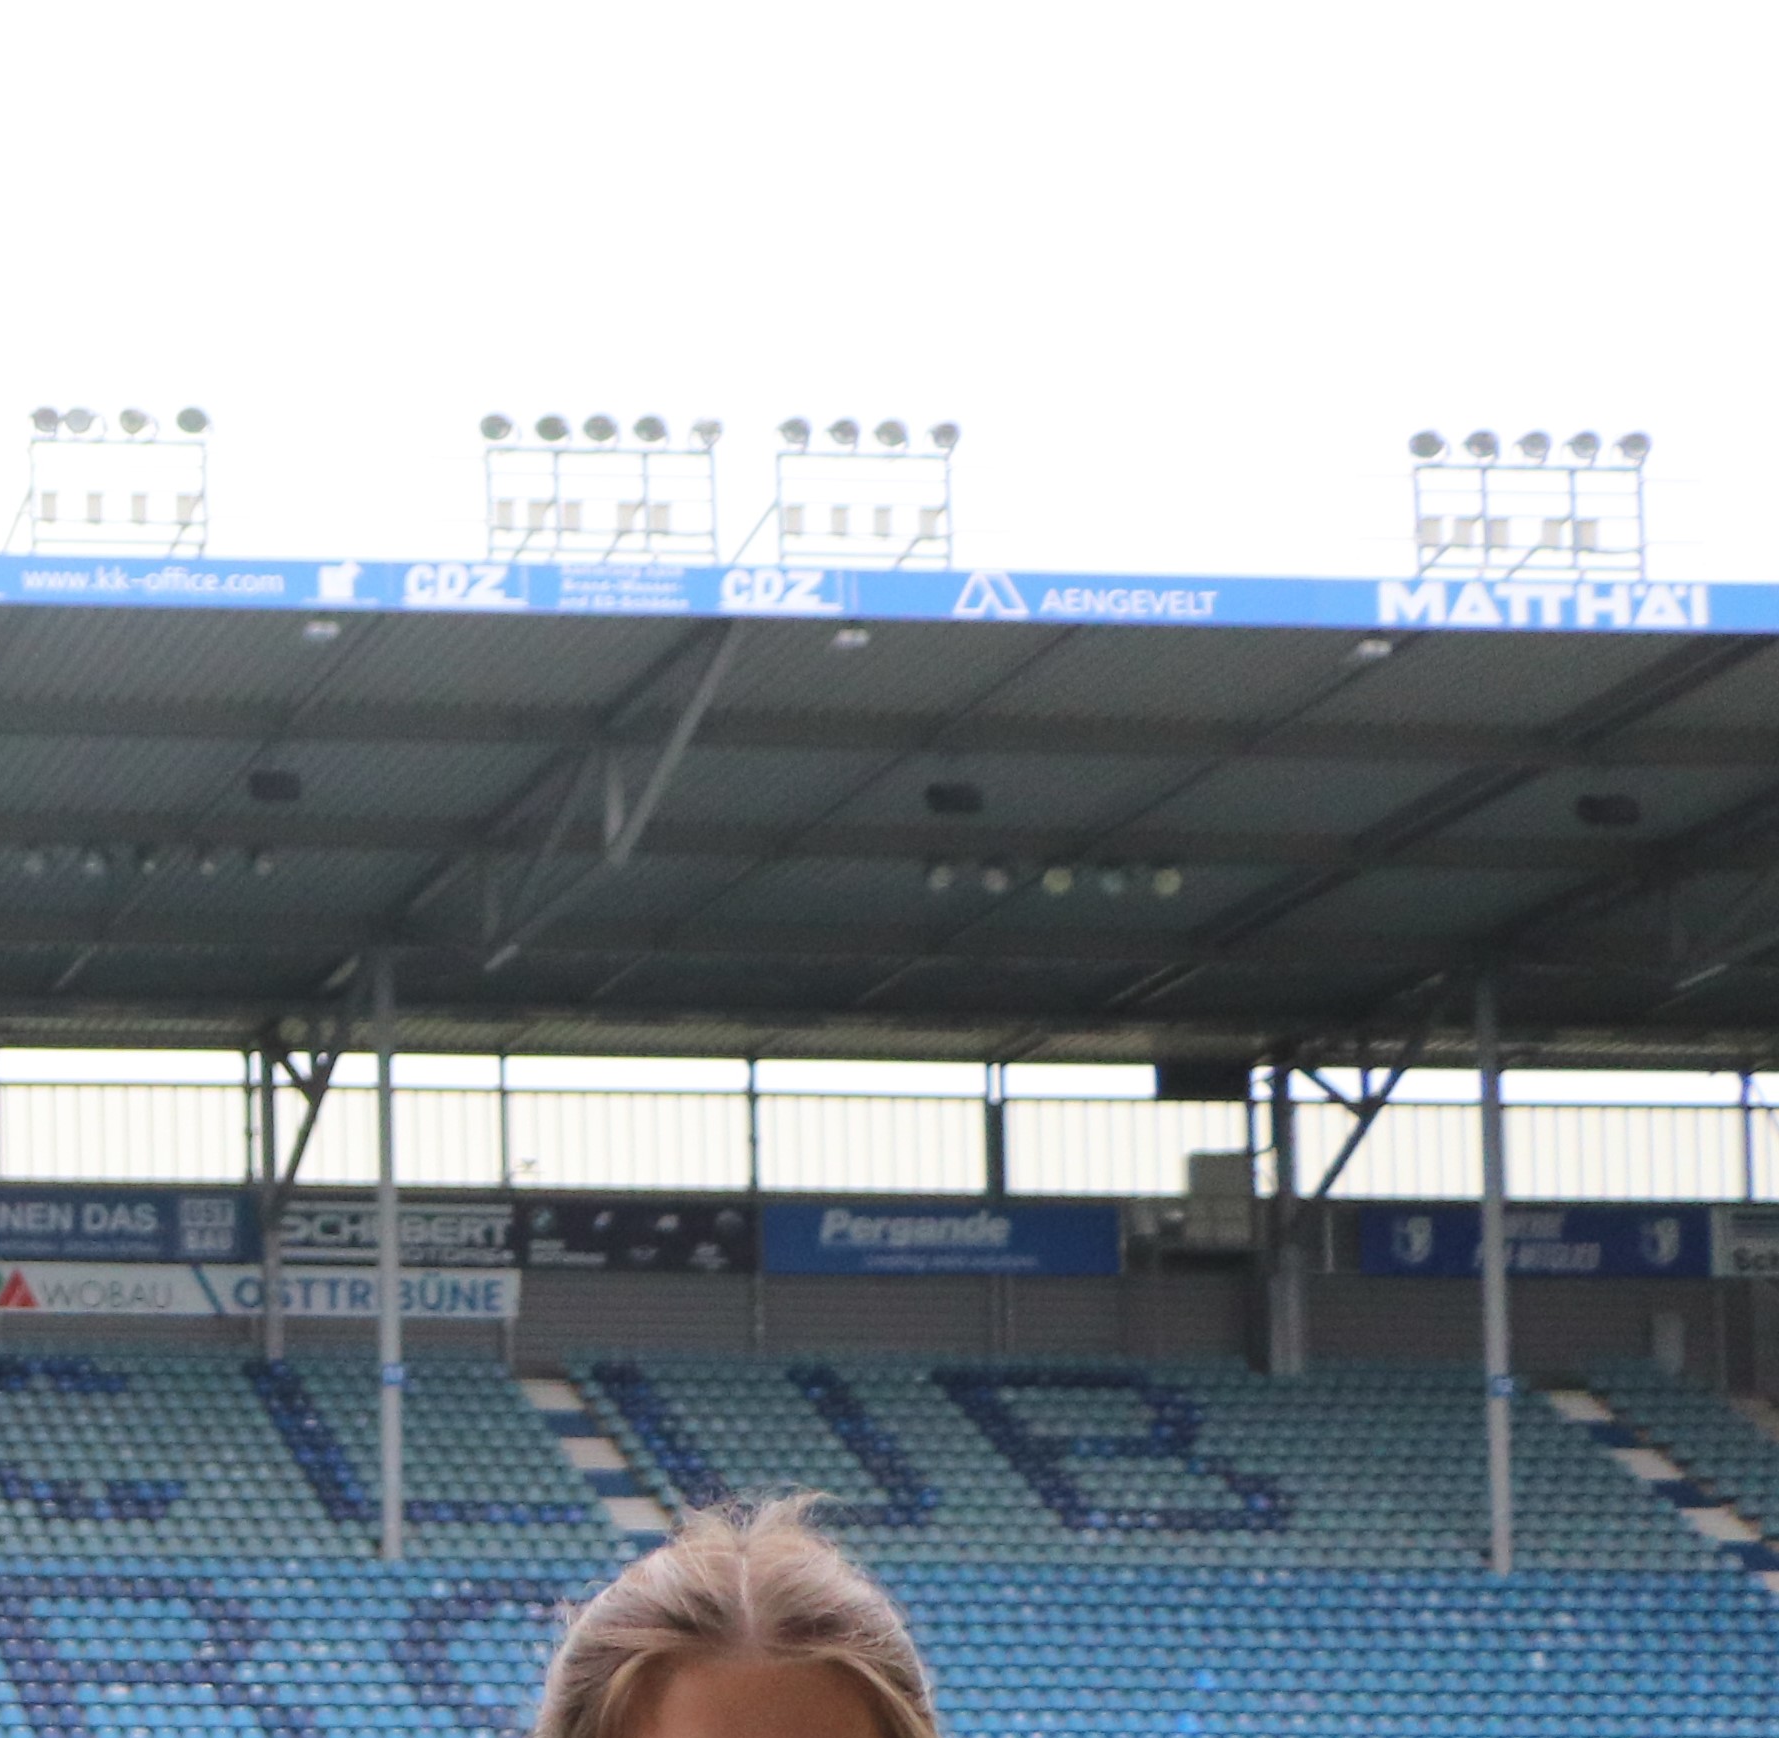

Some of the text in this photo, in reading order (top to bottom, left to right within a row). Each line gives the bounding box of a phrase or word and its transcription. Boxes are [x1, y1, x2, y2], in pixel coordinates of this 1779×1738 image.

[21, 566, 284, 595] www.kk-office.com
[1039, 587, 1219, 616] AENGEVELT
[1378, 580, 1709, 626] MATTHÄI
[81, 1202, 160, 1233] DAS
[281, 1215, 511, 1246] SCHBERT
[819, 1208, 1012, 1247] Pergande
[43, 1279, 173, 1308] WOBAU
